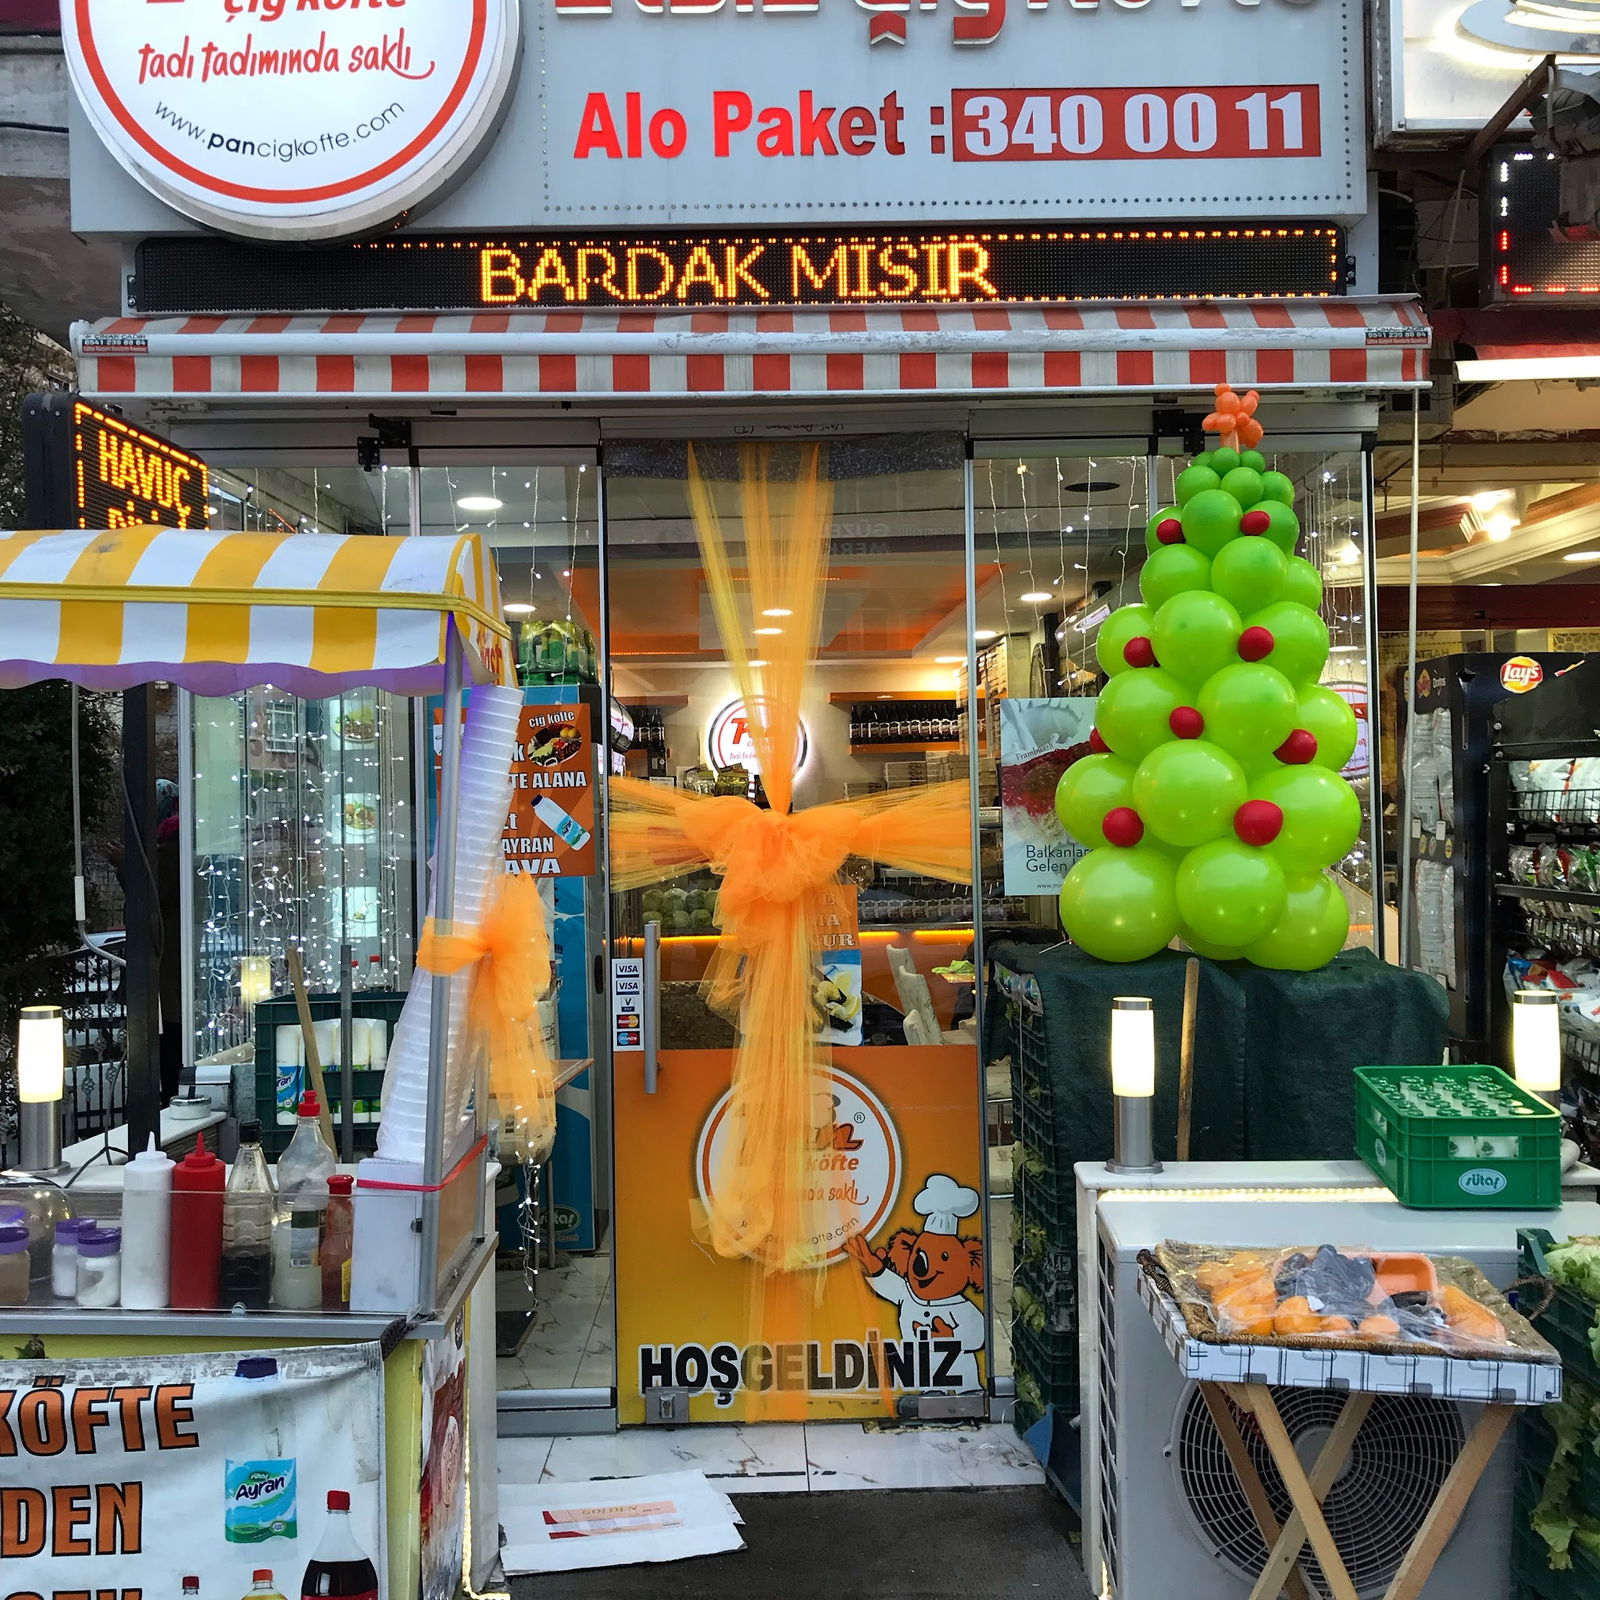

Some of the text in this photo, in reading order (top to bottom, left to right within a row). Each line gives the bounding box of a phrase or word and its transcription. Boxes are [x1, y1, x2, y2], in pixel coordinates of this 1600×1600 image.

[154, 101, 406, 160] www.pancigkofte.com
[573, 91, 688, 160] Alo
[713, 89, 906, 158] Paket
[963, 94, 1104, 156] 340
[1123, 92, 1218, 154] 00
[1235, 91, 1304, 151] 11
[480, 241, 998, 303] BARDAK MISIR
[532, 771, 588, 789] ALANA
[501, 836, 555, 854] AYRAN
[504, 857, 562, 876] AVA
[1025, 858, 1068, 873] Gelen
[618, 965, 639, 974] VISA
[618, 982, 639, 990] VISA
[638, 1328, 965, 1407] HOŞGELDİNİZ
[235, 1476, 286, 1501] Ayran
